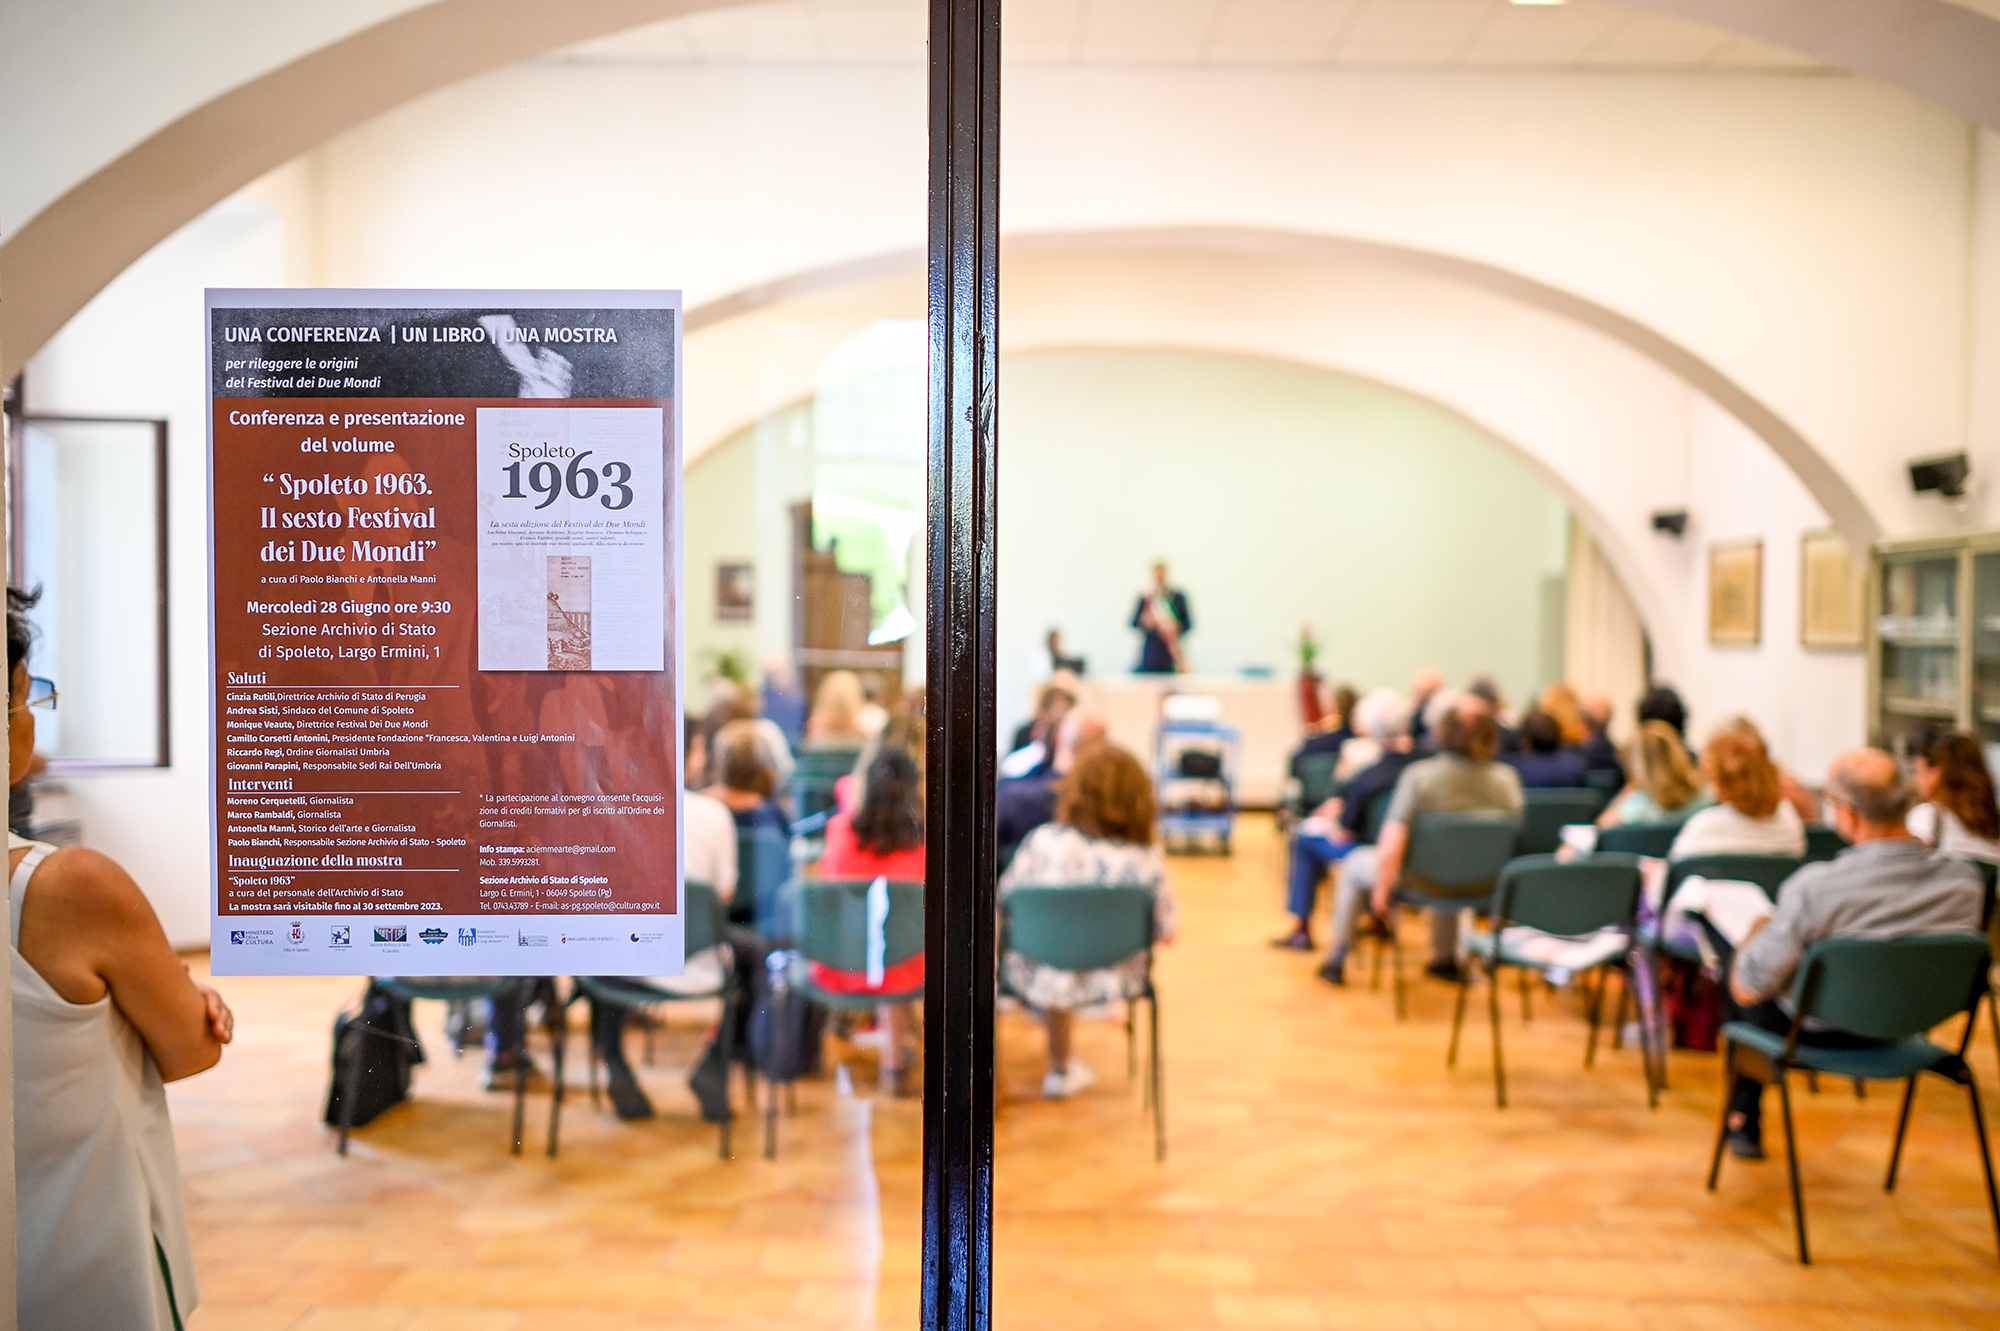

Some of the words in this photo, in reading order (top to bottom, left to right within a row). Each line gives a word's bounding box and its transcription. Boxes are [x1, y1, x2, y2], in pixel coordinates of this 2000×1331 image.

[224, 326, 263, 343] UNA
[266, 326, 381, 343] CONFERENZA
[402, 326, 428, 343] UN
[432, 326, 486, 343] LIBRO
[503, 326, 541, 343] UNA
[544, 326, 618, 343] MOSTRA
[225, 360, 247, 372] per
[248, 357, 303, 372] rileggere
[305, 357, 317, 369] le
[319, 356, 359, 372] origini
[225, 376, 245, 388] del
[247, 376, 294, 388] Festival
[296, 376, 316, 388] dei
[317, 377, 341, 388] Due
[343, 375, 382, 388] Mondi
[229, 409, 325, 425] Conferenza
[329, 413, 340, 425] e
[344, 408, 465, 429] presentazione
[300, 437, 328, 453] del
[331, 437, 395, 453] volume
[508, 441, 576, 462] Spoleto
[502, 450, 634, 511] 1963
[279, 473, 368, 500] Spoleto
[374, 473, 433, 495] 1963.
[261, 507, 277, 528] Il
[282, 509, 342, 529] sesto
[348, 506, 436, 529] Festival
[489, 520, 500, 528] La
[519, 520, 550, 529] edizione
[550, 520, 563, 528] del
[563, 520, 592, 528] Festival
[592, 520, 604, 528] dei
[605, 520, 621, 528] Due
[623, 520, 646, 528] Mondi
[260, 540, 295, 562] dei
[301, 540, 346, 562] Due
[300, 575, 324, 584] Paolo
[326, 574, 358, 584] Bianchi
[366, 574, 408, 584] Antonella
[410, 574, 436, 584] Manni
[247, 599, 317, 614] Mercoledì
[320, 601, 338, 614] 28
[341, 599, 391, 617] Giugno
[394, 603, 418, 614] ore
[421, 601, 451, 614] 9:30
[262, 622, 317, 636] Sezione
[320, 622, 377, 636] Archivio
[381, 622, 395, 636] di
[399, 623, 436, 636] Stato
[258, 644, 272, 658] di
[276, 645, 334, 661] Spoleto,
[338, 645, 377, 661] Largo
[381, 644, 430, 660] Ermini,
[433, 646, 440, 658] 1
[228, 671, 266, 684] Saluti
[226, 692, 252, 701] Cinzia
[316, 692, 350, 701] Archivio
[361, 692, 384, 701] Stato
[395, 692, 426, 703] Perugia
[226, 706, 257, 715] Andrea
[258, 705, 281, 716] Sisti,
[282, 705, 317, 715] Sindaco
[333, 706, 369, 715] Comune
[381, 706, 415, 716] Spoleto
[226, 719, 263, 730] Monique
[263, 720, 295, 730] Veaute,
[296, 719, 335, 729] Direttrice
[336, 719, 368, 729] Festival
[402, 719, 428, 729] Mondi
[226, 733, 258, 743] Camillo
[259, 733, 292, 743] Corsetti
[293, 733, 331, 744] Antonini,
[332, 733, 376, 742] Presidente
[377, 733, 424, 742] Fondazione
[472, 733, 511, 742] Valentina
[519, 733, 539, 744] Luigi
[540, 733, 575, 742] Antonini
[227, 747, 263, 756] Riccardo
[264, 747, 285, 758] Regi,
[286, 747, 314, 756] Ordine
[315, 747, 358, 756] Giornalisti
[360, 747, 390, 756] Umbria
[226, 761, 263, 770] Giovanni
[264, 761, 301, 772] Parapini,
[302, 761, 358, 772] Responsabile
[359, 761, 377, 770] Sedi
[379, 761, 392, 770] Rai
[229, 777, 293, 791] Interventi
[227, 797, 259, 805] Moreno
[260, 796, 308, 807] Cerquetelli,
[309, 796, 354, 805] Giornalista
[496, 793, 550, 804] partecipazione
[560, 795, 596, 804] convegno
[596, 795, 631, 803] consente
[227, 811, 253, 819] Marco
[254, 809, 296, 820] Rambaldi,
[297, 810, 342, 819] Giornalista
[479, 806, 499, 815] zione
[509, 806, 532, 815] crediti
[534, 806, 566, 815] formativi
[593, 805, 616, 815] iscritti
[227, 824, 268, 833] Antonella
[269, 823, 297, 834] Manni,
[298, 823, 327, 833] Storico
[371, 823, 416, 832] Giornalista
[479, 819, 518, 828] Giornalisti.
[228, 838, 251, 847] Paolo
[251, 837, 282, 848] Bianchi,
[283, 837, 335, 848] Responsabile
[336, 837, 367, 846] Sezione
[367, 837, 399, 846] Archivio
[409, 837, 430, 846] Stato
[436, 837, 467, 848] Spoleto
[479, 844, 495, 854] Info
[495, 845, 525, 855] stampa:
[525, 844, 616, 855] aciemmearte@gmail.com
[229, 854, 319, 869] Inauguazione
[321, 854, 354, 867] della
[356, 855, 403, 866] mostra
[479, 858, 497, 867] Mob.
[273, 888, 316, 899] personale
[381, 888, 404, 897] Stato
[479, 889, 500, 899] Largo
[509, 888, 535, 898] Ermini,
[545, 888, 568, 897] 06049
[569, 888, 597, 899] Spoleto
[597, 887, 612, 899] (Pg)
[241, 903, 272, 911] mostra
[273, 901, 292, 911] sarà
[293, 901, 333, 911] visitabile
[334, 901, 352, 911] fino
[375, 901, 419, 911] settembre
[420, 902, 443, 911] 2023.
[535, 901, 560, 910] E-mail:
[560, 900, 660, 912] as-pg.spoleto@cultura.gov.it
